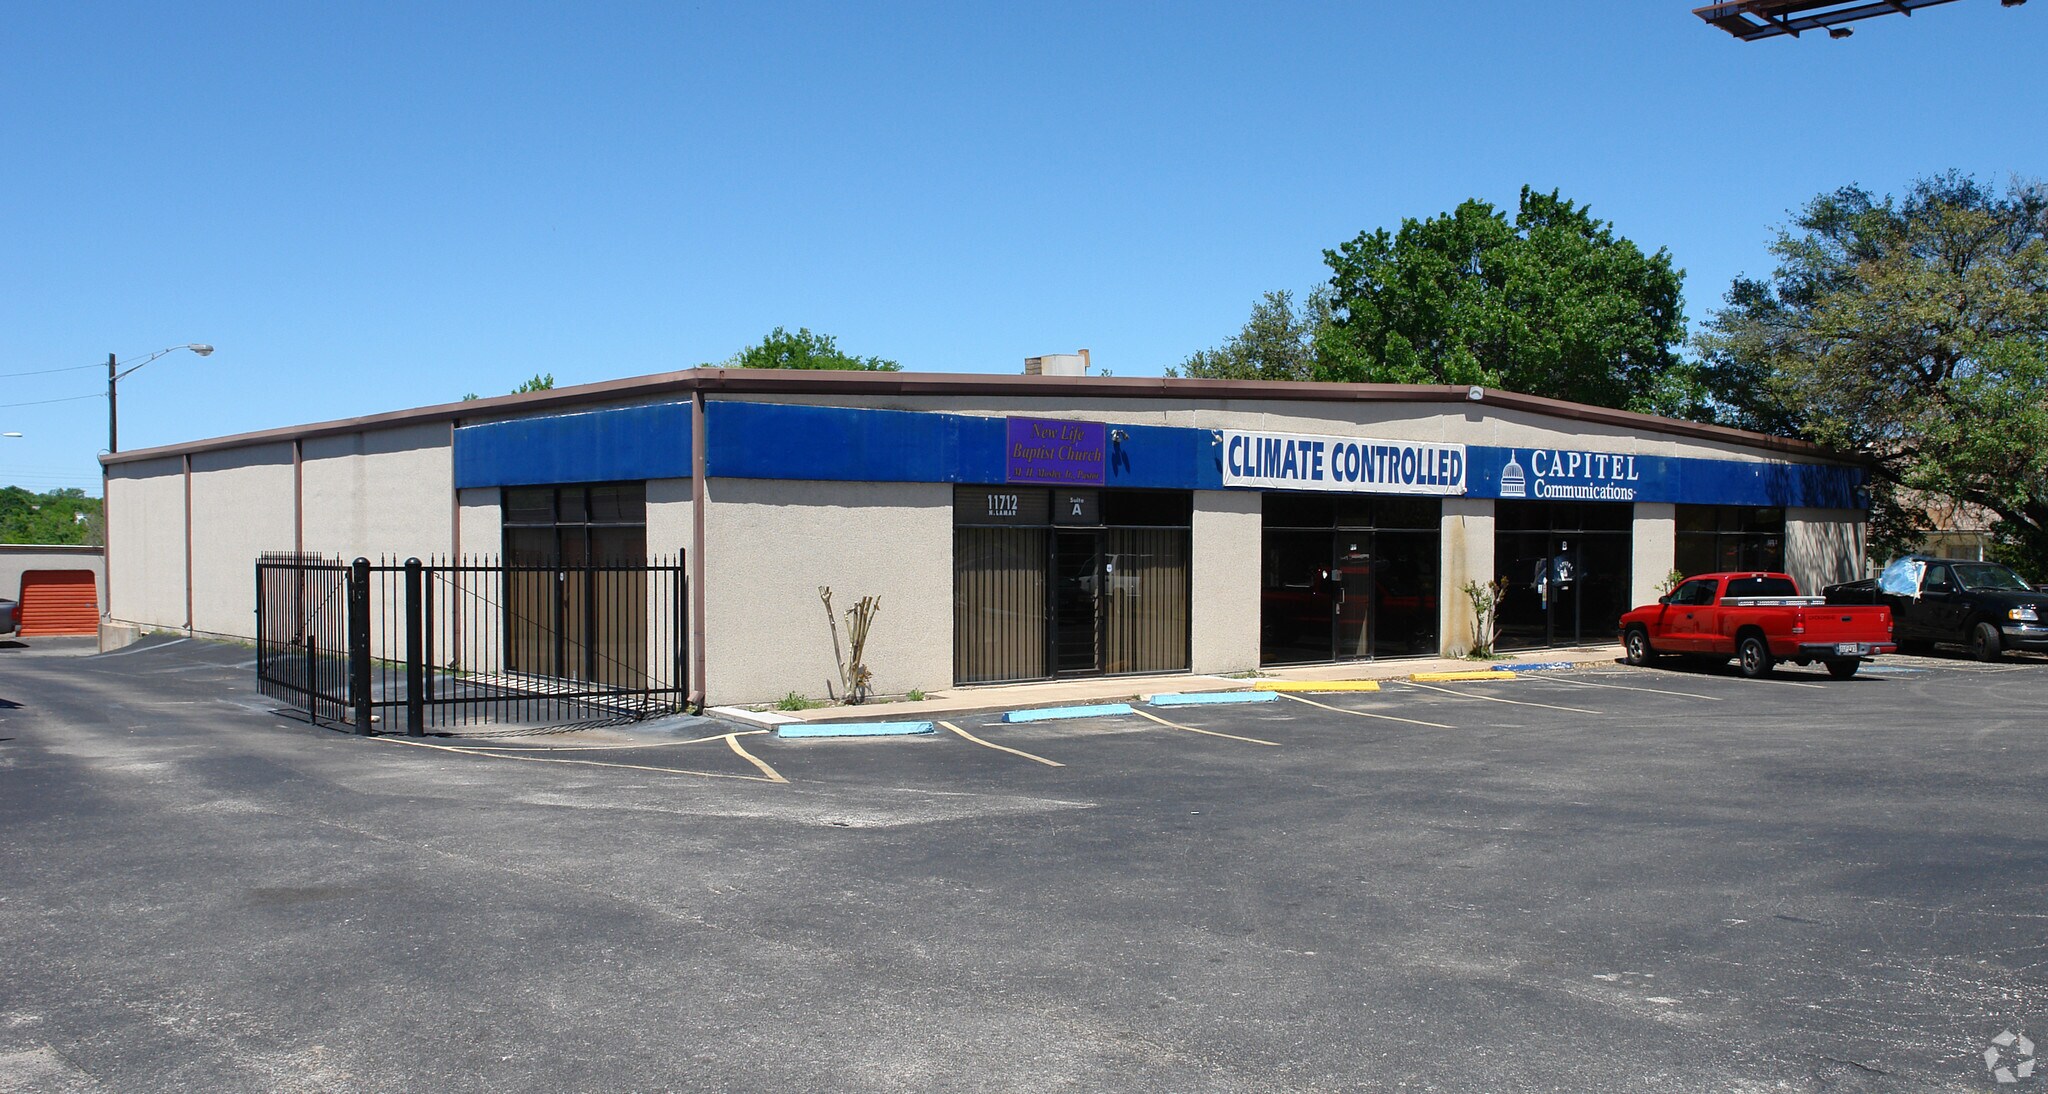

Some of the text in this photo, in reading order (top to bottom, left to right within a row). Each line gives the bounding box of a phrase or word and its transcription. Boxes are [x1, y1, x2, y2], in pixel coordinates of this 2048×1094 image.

[1031, 423, 1085, 444] New Life
[1013, 442, 1101, 462] Baptist Church
[1228, 435, 1463, 486] CLIMATE CONTROLLED
[1077, 470, 1099, 480] Pastor
[1531, 450, 1639, 481] CAPITEL
[1534, 479, 1633, 500] Communications
[988, 494, 1018, 510] 11712
[1072, 503, 1082, 515] A
